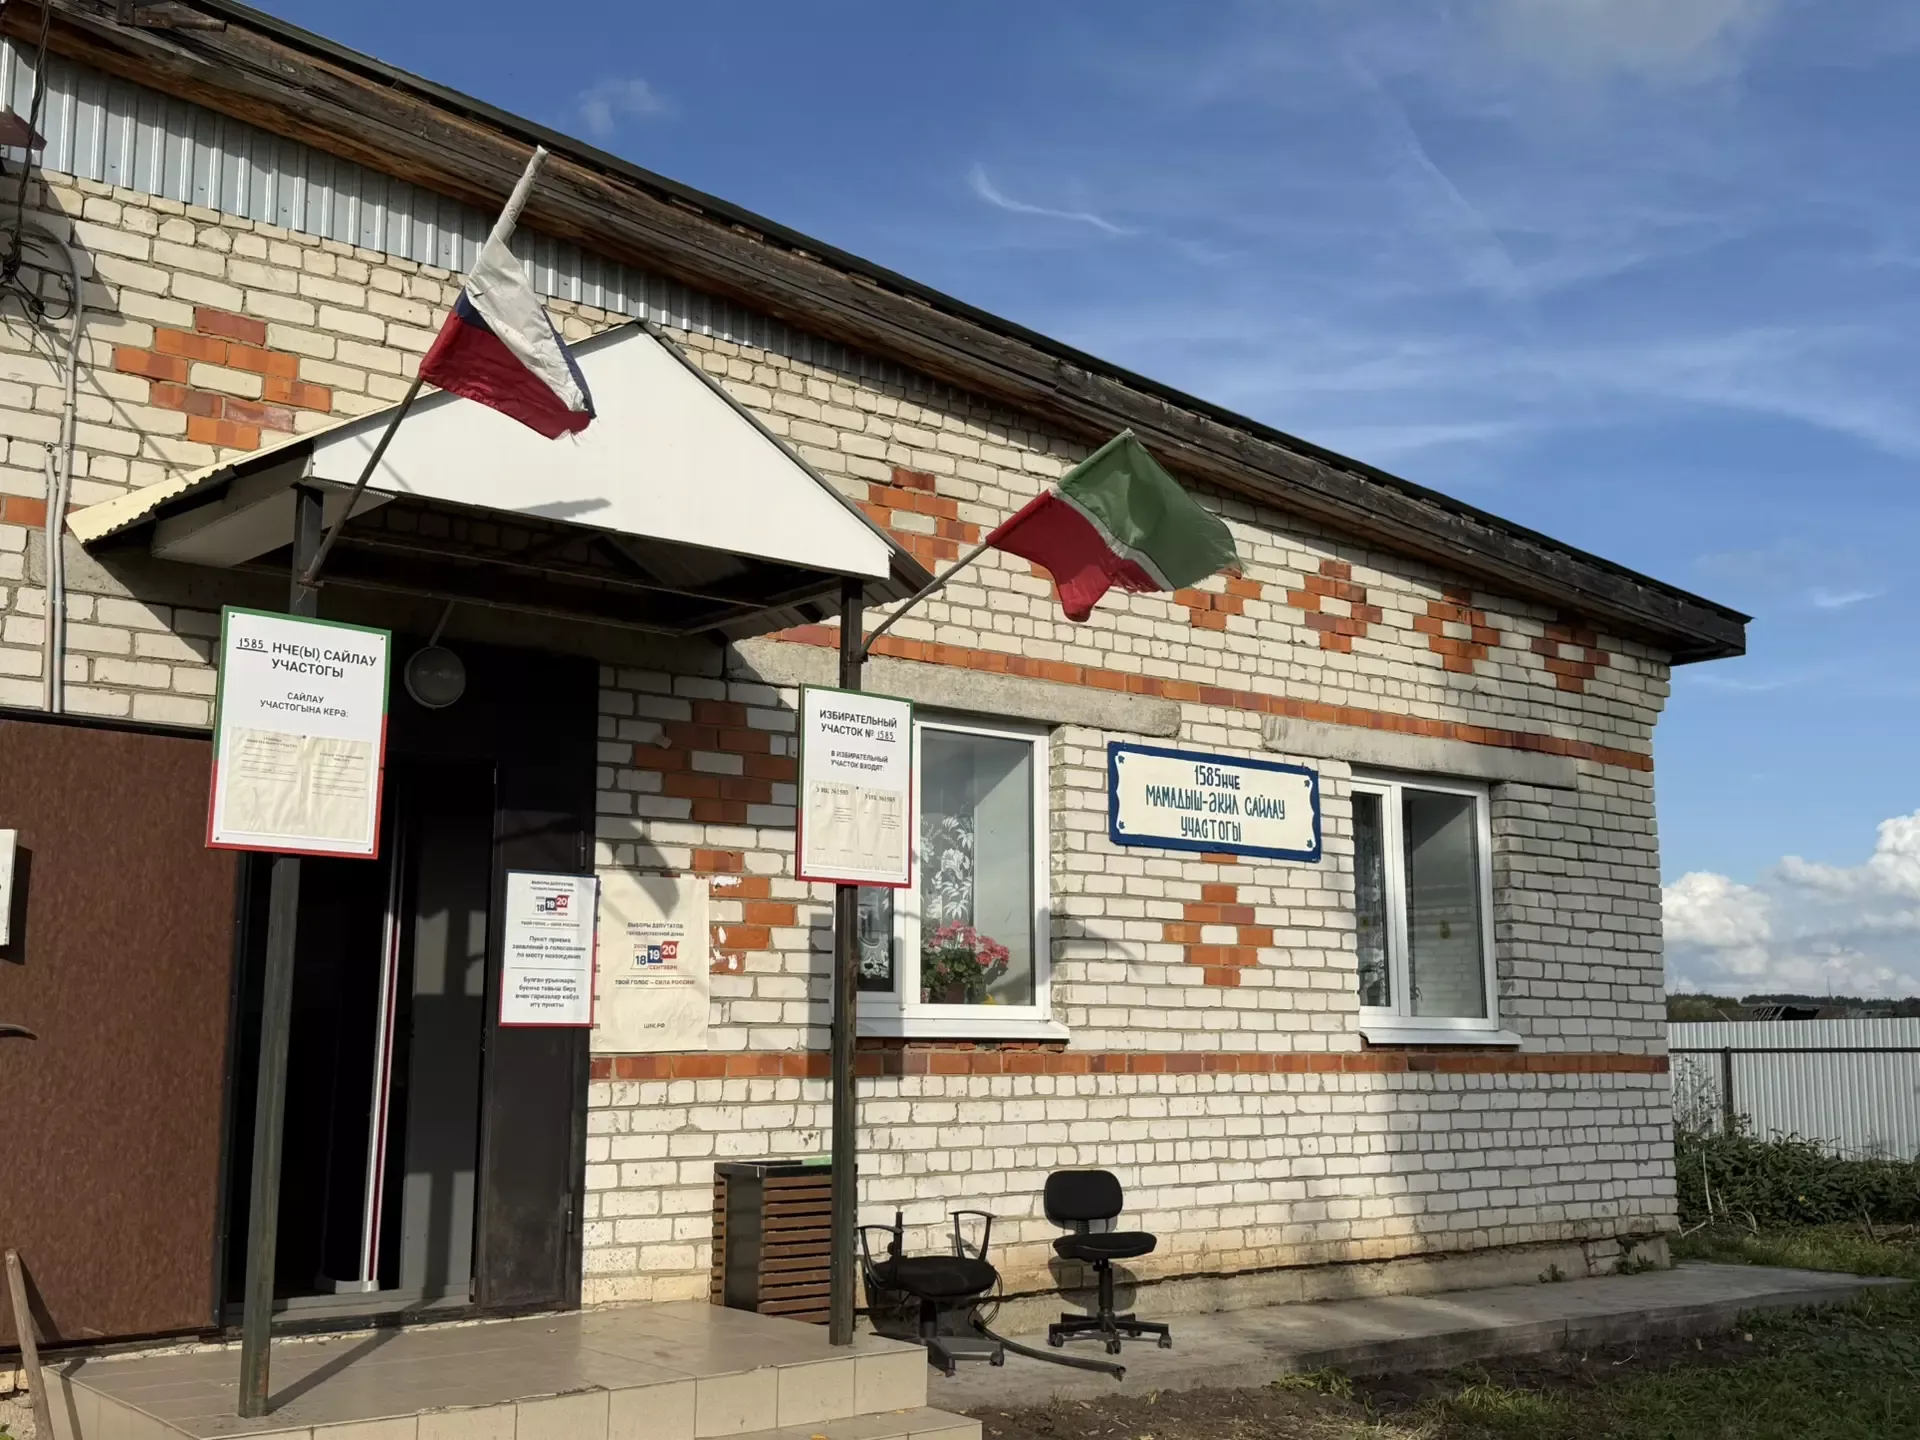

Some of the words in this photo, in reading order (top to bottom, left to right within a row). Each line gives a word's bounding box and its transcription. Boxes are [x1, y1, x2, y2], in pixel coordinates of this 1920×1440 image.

[239, 637, 264, 649] 1585
[323, 649, 377, 667] САЙЛАУ
[271, 658, 344, 678] УЧАСТОГЫ
[287, 692, 324, 704] САЙЛАУ
[260, 699, 321, 715] УЧАСТОГЫНА
[819, 709, 897, 728] ИЗБИРАТЕЛЬНЫЙ
[821, 723, 863, 737] УЧАСТОК
[877, 730, 894, 740] 1585
[830, 759, 859, 769] УЧАСТОК
[836, 751, 888, 763] ИЗБИРАТЕЛЬНЫЙ
[1146, 784, 1239, 815] МАМАДЫШ-ӘКИЛ
[1244, 794, 1285, 820] САЙЛАУ
[1181, 815, 1242, 842] УЧАСТОГЫ
[536, 904, 545, 912] 18
[546, 900, 555, 909] 19
[556, 897, 567, 906] 20
[529, 935, 548, 943] Пункт
[635, 955, 647, 965] 18
[648, 949, 660, 960] 19
[662, 944, 676, 955] 20
